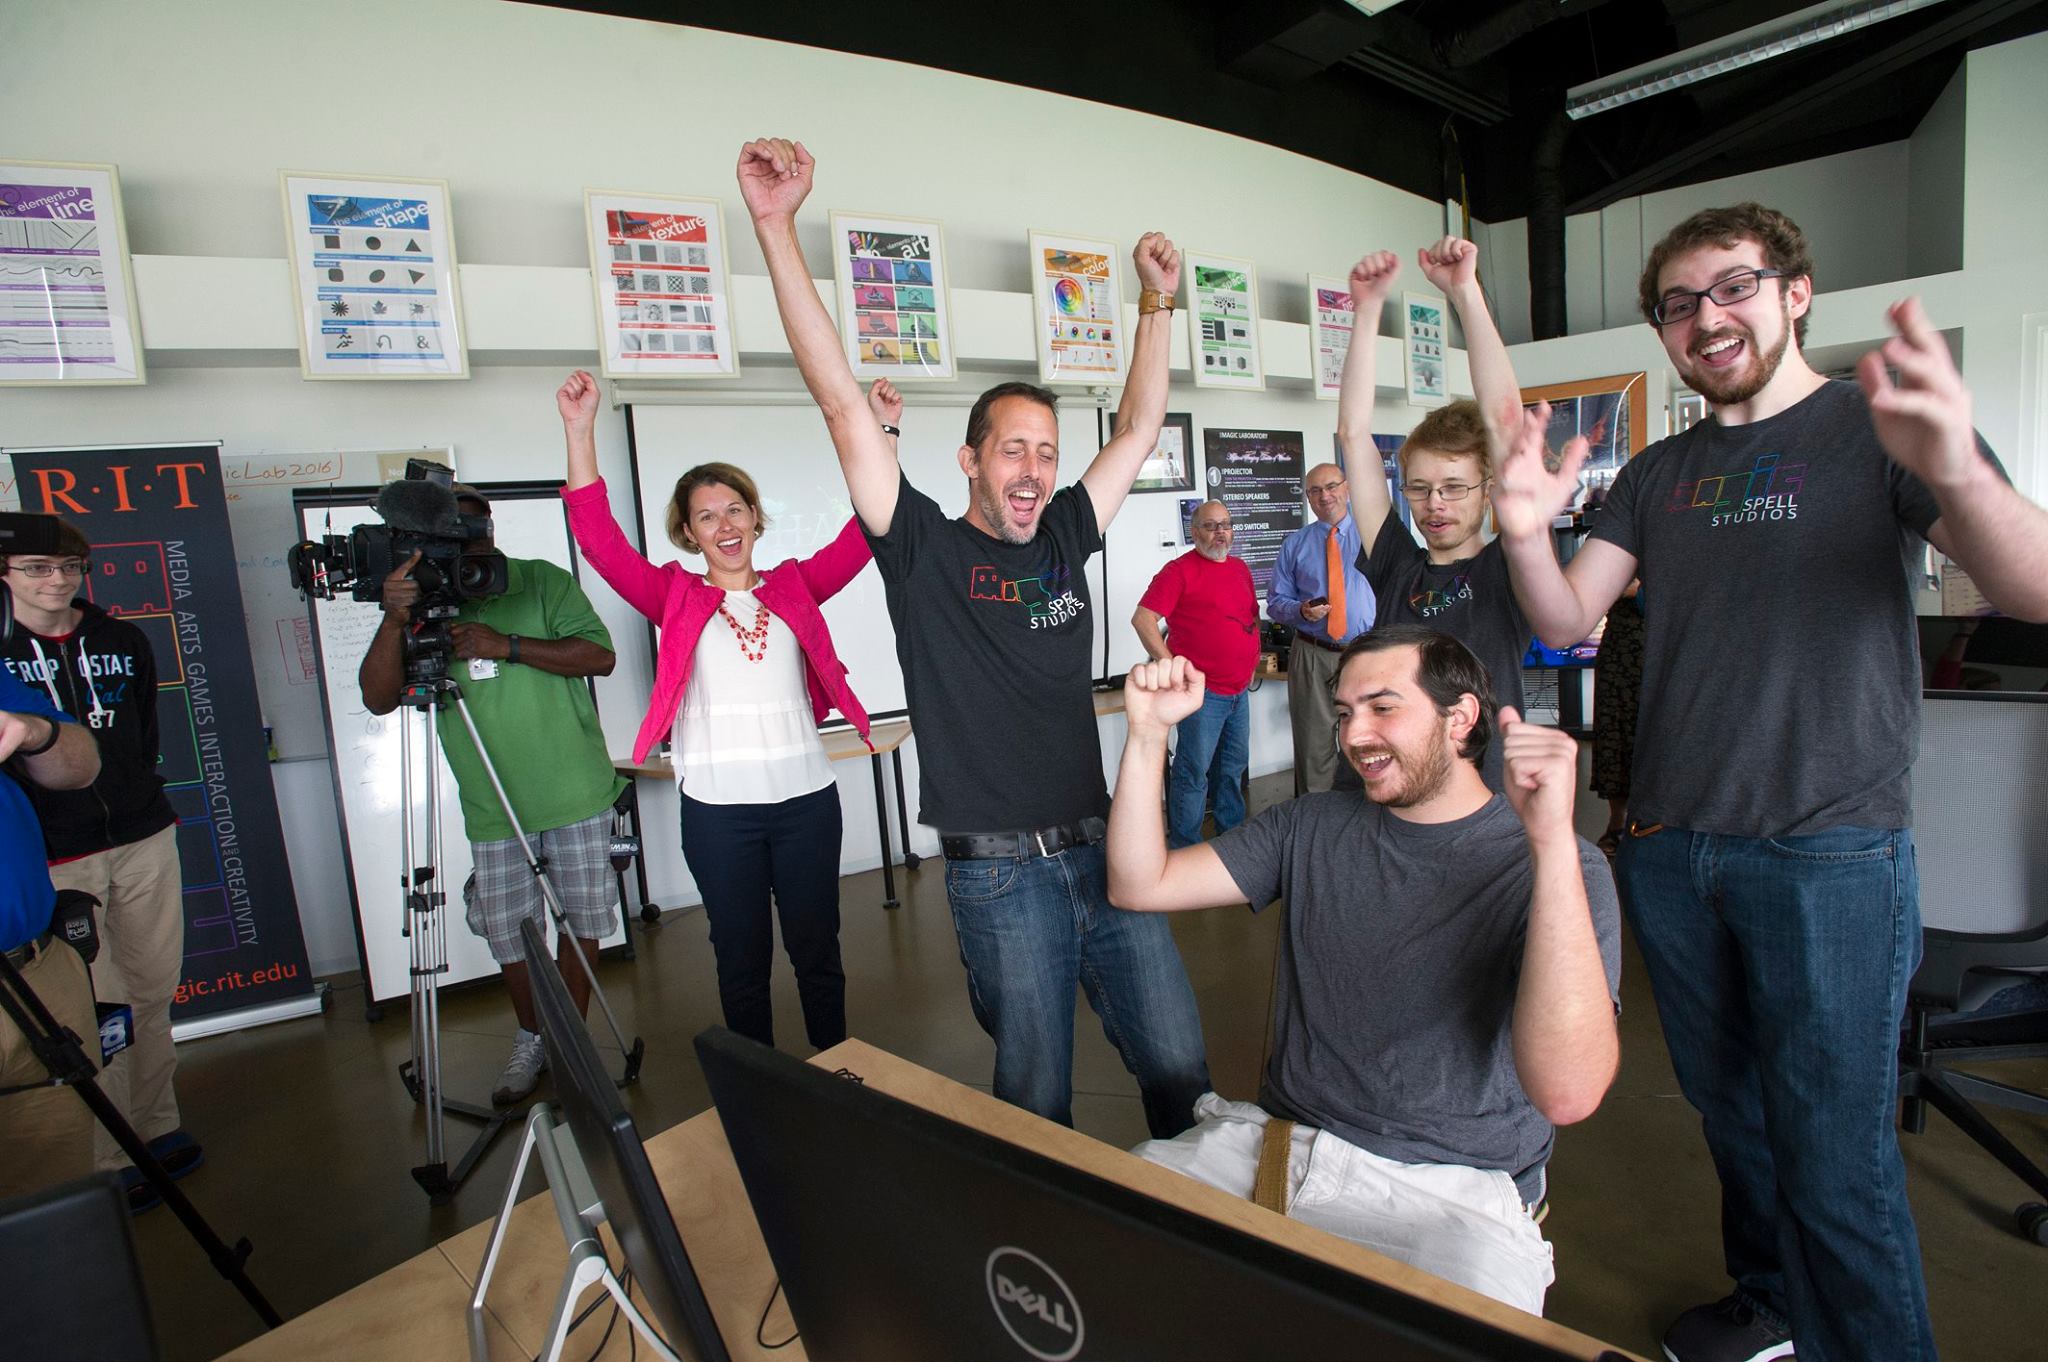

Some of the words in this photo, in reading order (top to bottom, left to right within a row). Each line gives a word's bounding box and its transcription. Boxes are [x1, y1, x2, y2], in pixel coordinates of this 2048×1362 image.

[0, 208, 16, 217] he
[17, 191, 66, 212] element
[67, 186, 79, 197] of
[46, 198, 95, 220] line
[333, 216, 351, 227] the
[374, 203, 429, 228] shape
[648, 216, 707, 241] texture
[901, 234, 930, 260] art
[1082, 259, 1109, 275] color
[1210, 469, 1217, 483] 1
[1742, 494, 1798, 512] SPELL
[1232, 523, 1244, 531] DEO
[1244, 522, 1269, 530] SWITCHER
[1711, 508, 1797, 527] STUDIOS
[166, 540, 192, 600] MEDIA
[177, 611, 202, 655] ARTS
[187, 662, 215, 725] GAMES
[87, 709, 115, 729] 87
[199, 732, 238, 848] INTERACTION
[222, 847, 240, 857] AND
[223, 857, 259, 945] CREATIVITY
[175, 961, 297, 1004] gic.rit.edu
[996, 1273, 1073, 1334] DELL
